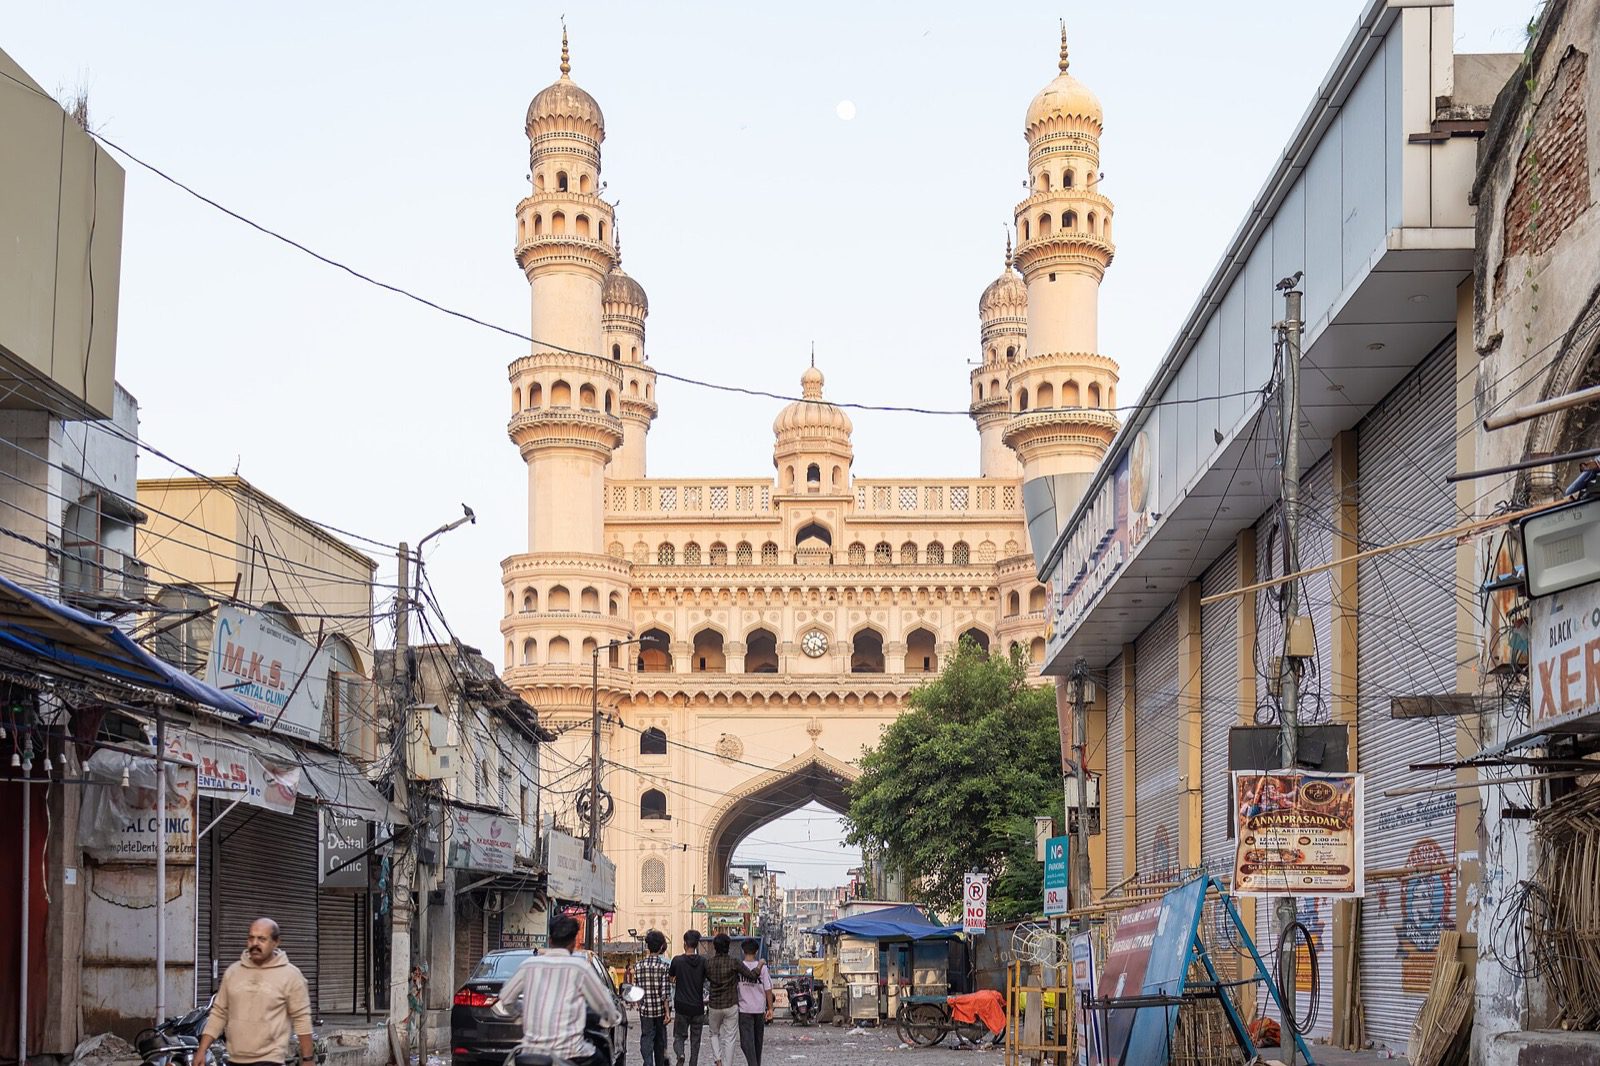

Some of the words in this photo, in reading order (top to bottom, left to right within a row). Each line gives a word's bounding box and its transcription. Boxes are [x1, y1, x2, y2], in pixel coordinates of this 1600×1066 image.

[1550, 617, 1572, 648] BLACK
[222, 641, 285, 691] M.K.S.
[1538, 636, 1600, 720] XER
[233, 678, 263, 700] DENTAL
[270, 719, 293, 733] HDERABAD
[199, 776, 227, 788] ENTAL
[148, 818, 190, 834] CINIC
[1252, 815, 1342, 829] ANNAPRASADAM
[327, 832, 364, 849] Dental
[329, 855, 362, 872] Clinic
[1048, 862, 1065, 871] PARKING
[967, 907, 984, 918] NO
[965, 918, 987, 928] PARKING
